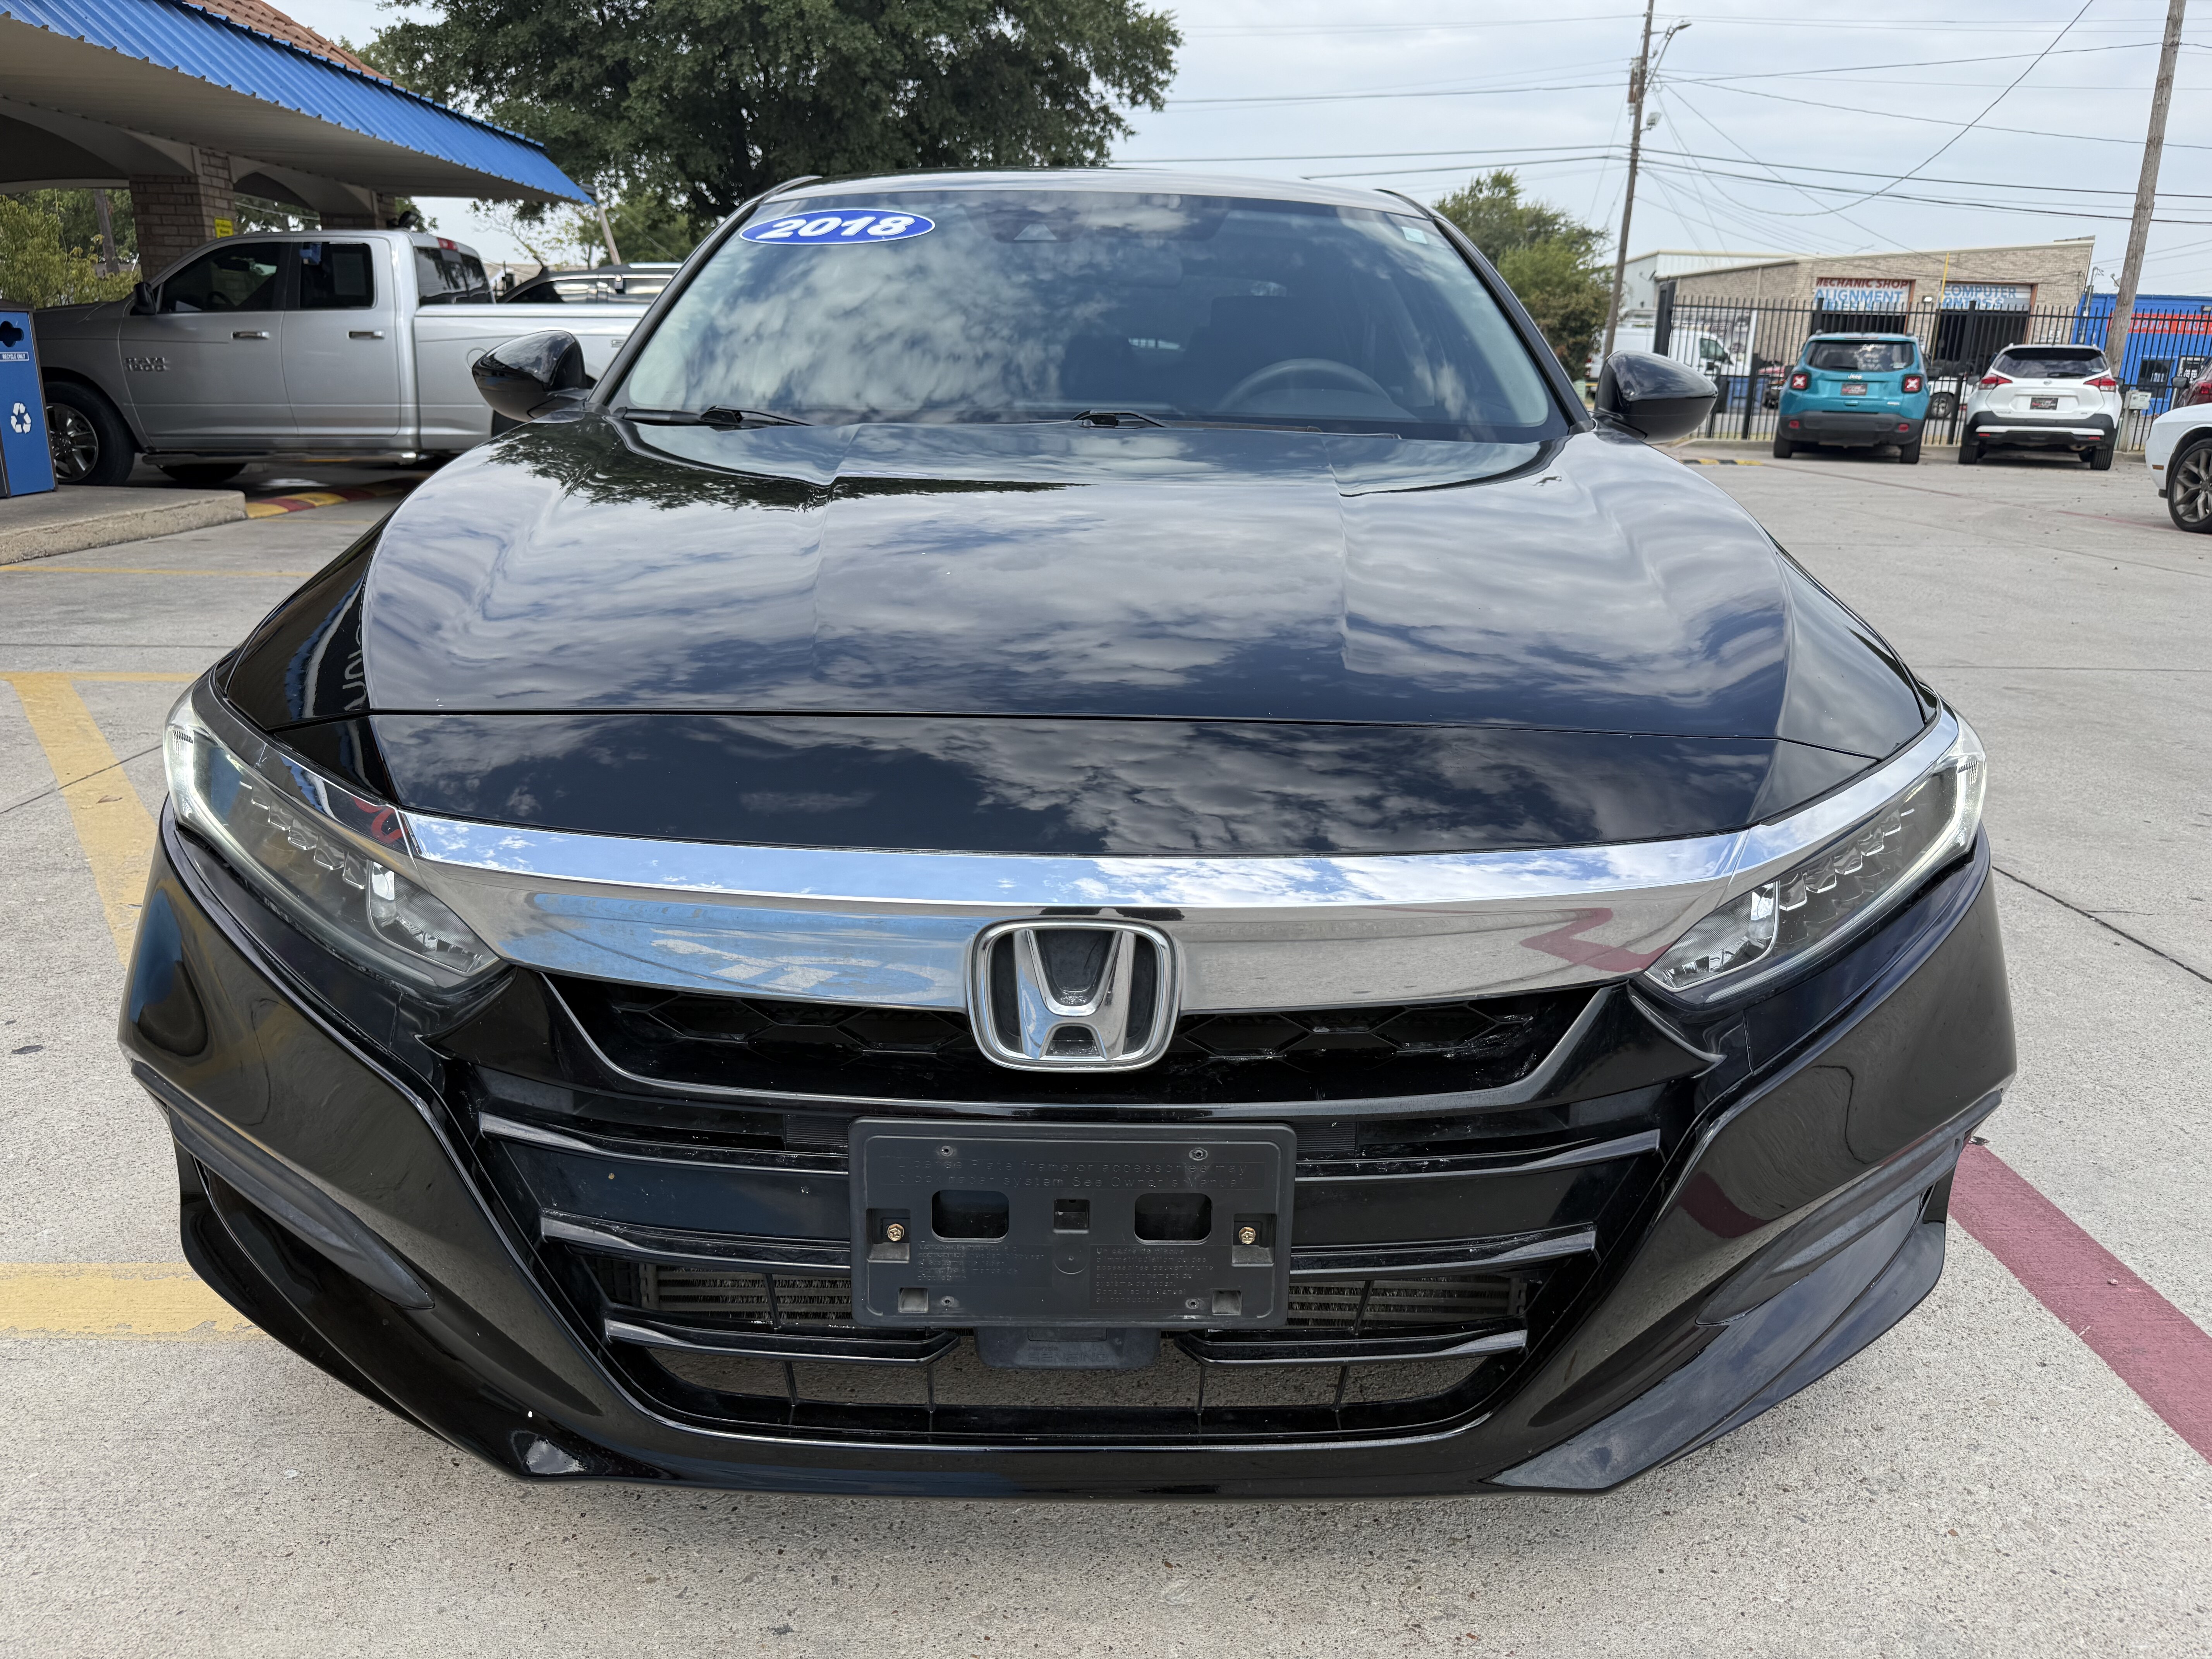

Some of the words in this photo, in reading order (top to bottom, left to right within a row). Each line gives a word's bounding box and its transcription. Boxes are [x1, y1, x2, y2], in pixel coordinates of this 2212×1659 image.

[754, 216, 915, 240] 2018
[1816, 278, 1874, 288] MECHANIC
[1876, 279, 1909, 289] SHOP
[1813, 289, 1903, 302] ALIGNMENT
[1943, 285, 2016, 298] COMPUTER
[1021, 1161, 1069, 1171] frame
[1076, 1164, 1093, 1172] or
[1102, 1163, 1207, 1173] accessories
[1215, 1165, 1247, 1175] may
[1072, 1176, 1103, 1187] See
[1028, 1352, 1108, 1362] SENSING
